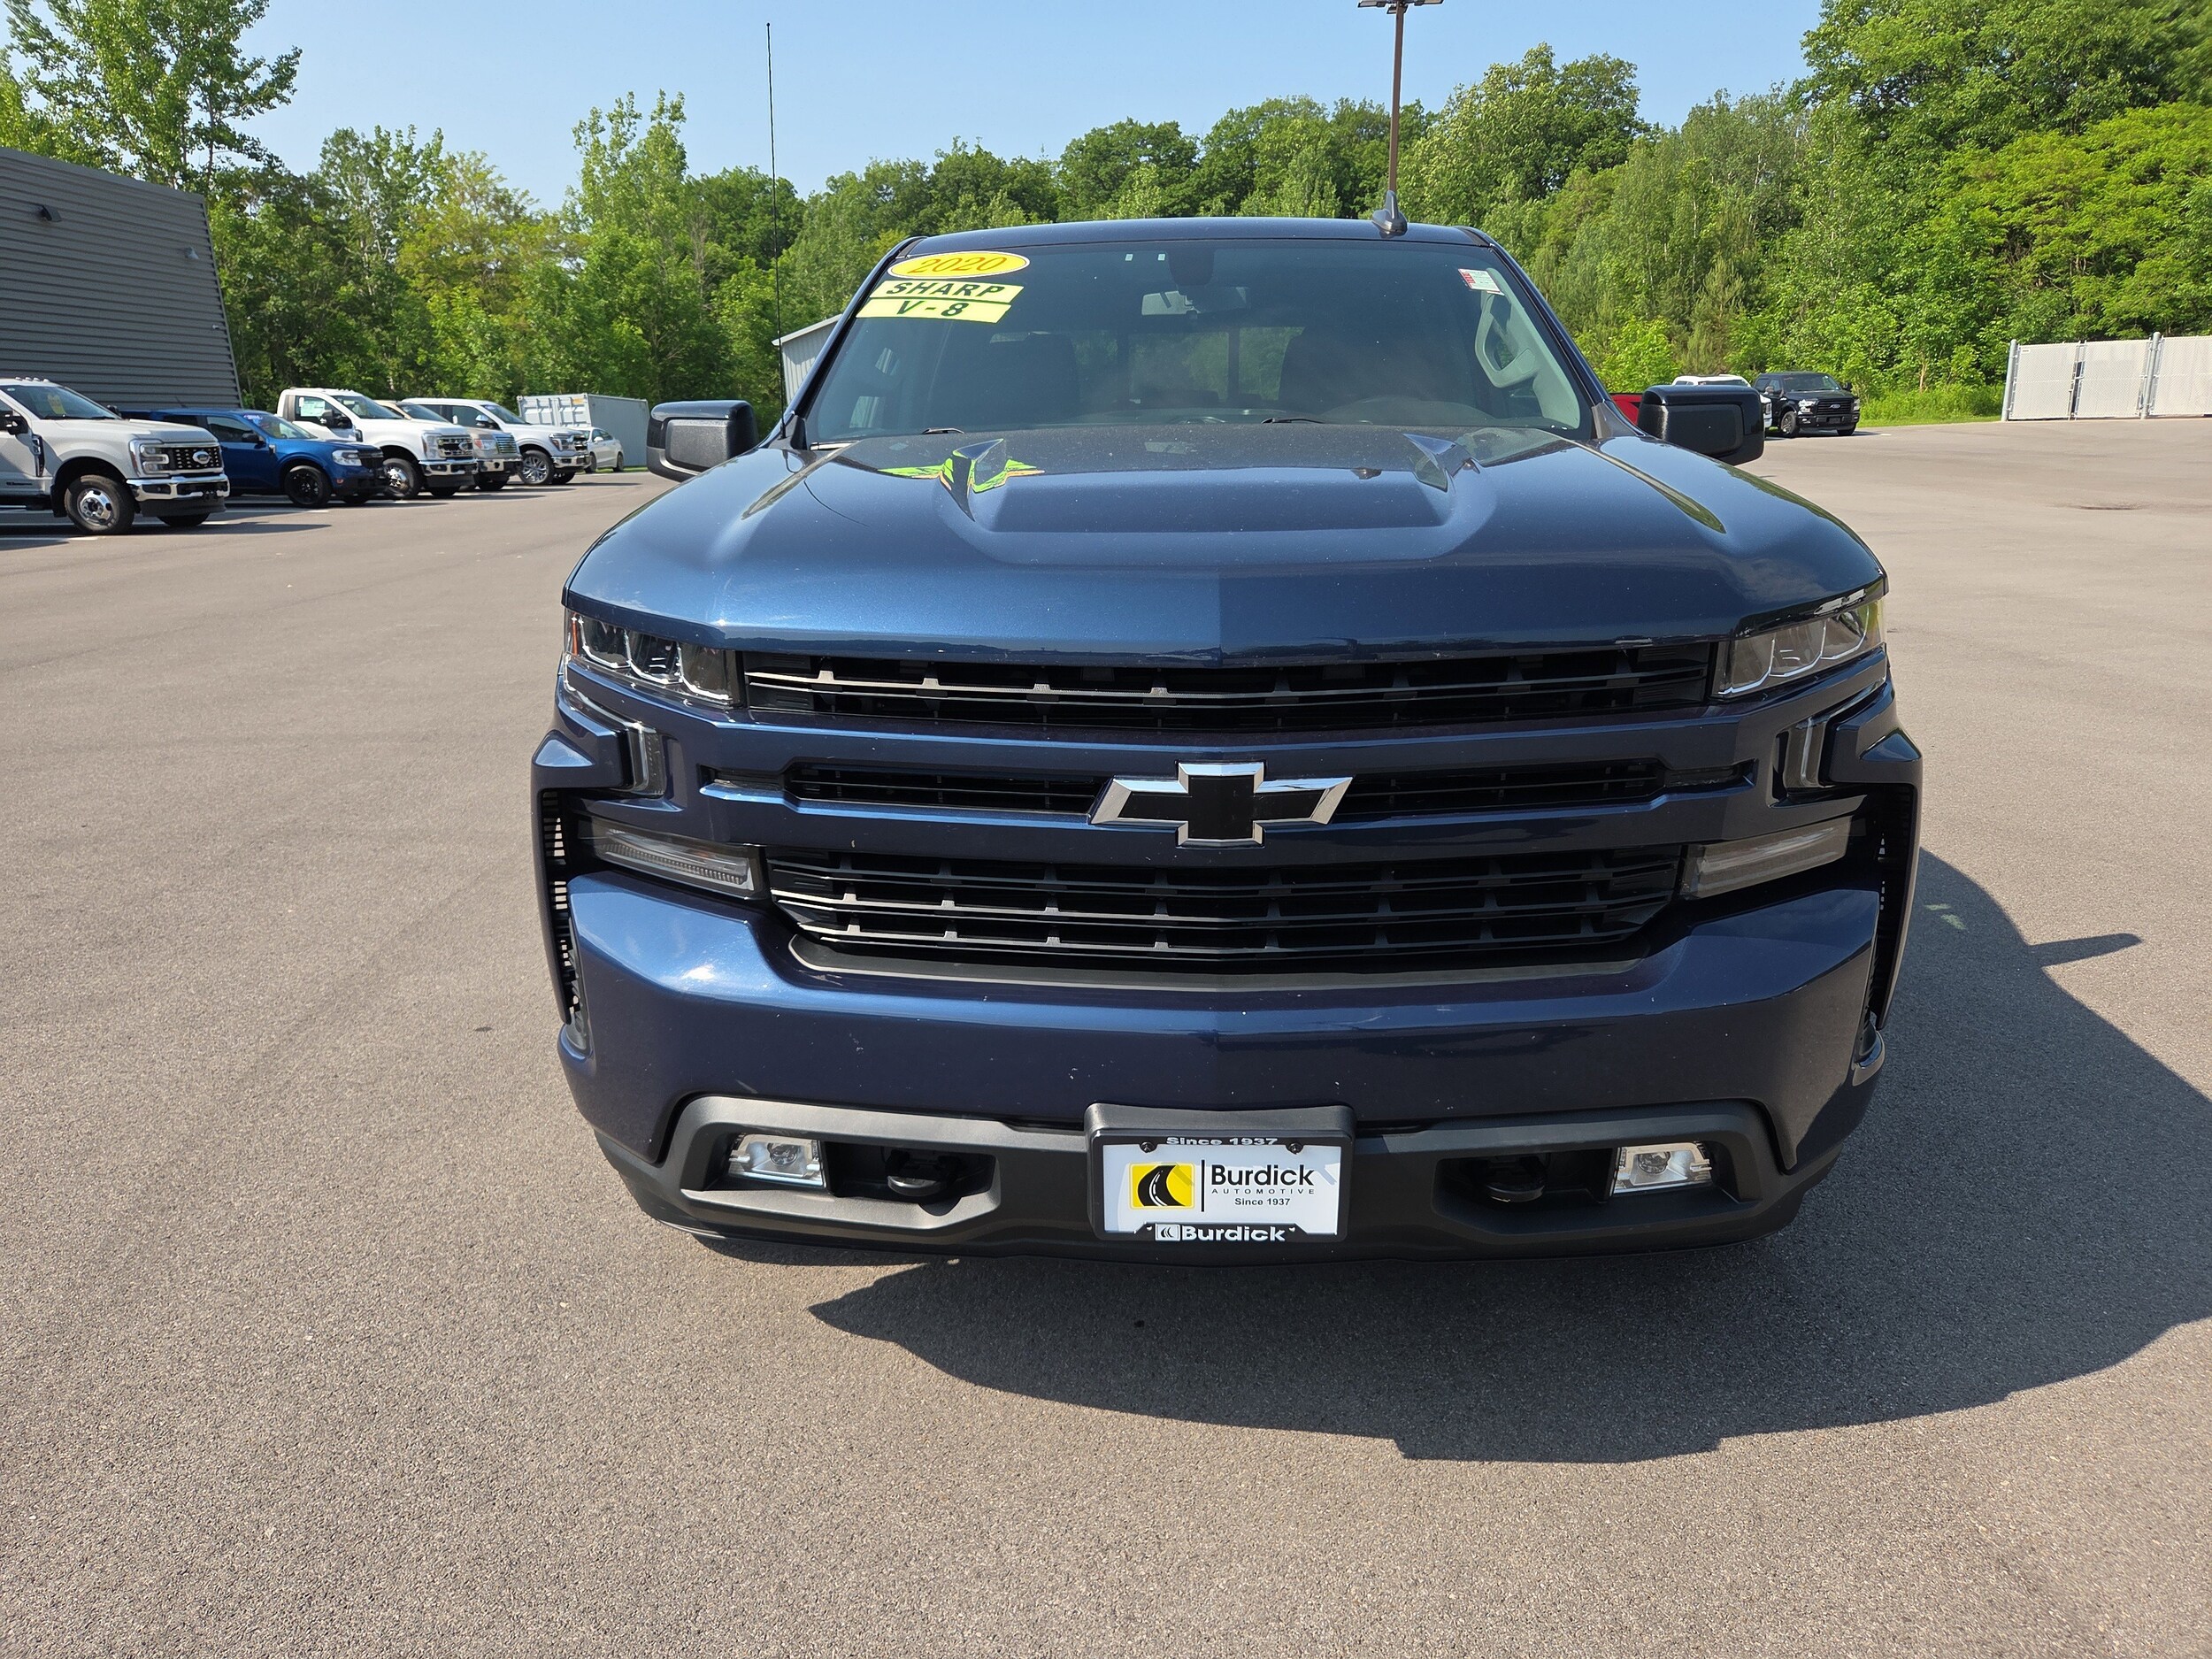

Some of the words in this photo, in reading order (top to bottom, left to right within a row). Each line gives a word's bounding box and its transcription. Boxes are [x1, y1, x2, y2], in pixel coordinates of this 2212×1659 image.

[907, 257, 1008, 274] 2020
[886, 281, 1005, 297] SHARP
[1165, 1137, 1223, 1146] Since
[1210, 1164, 1315, 1186] Burdick
[1234, 1197, 1263, 1206] Since
[1181, 1225, 1286, 1242] Burdick
